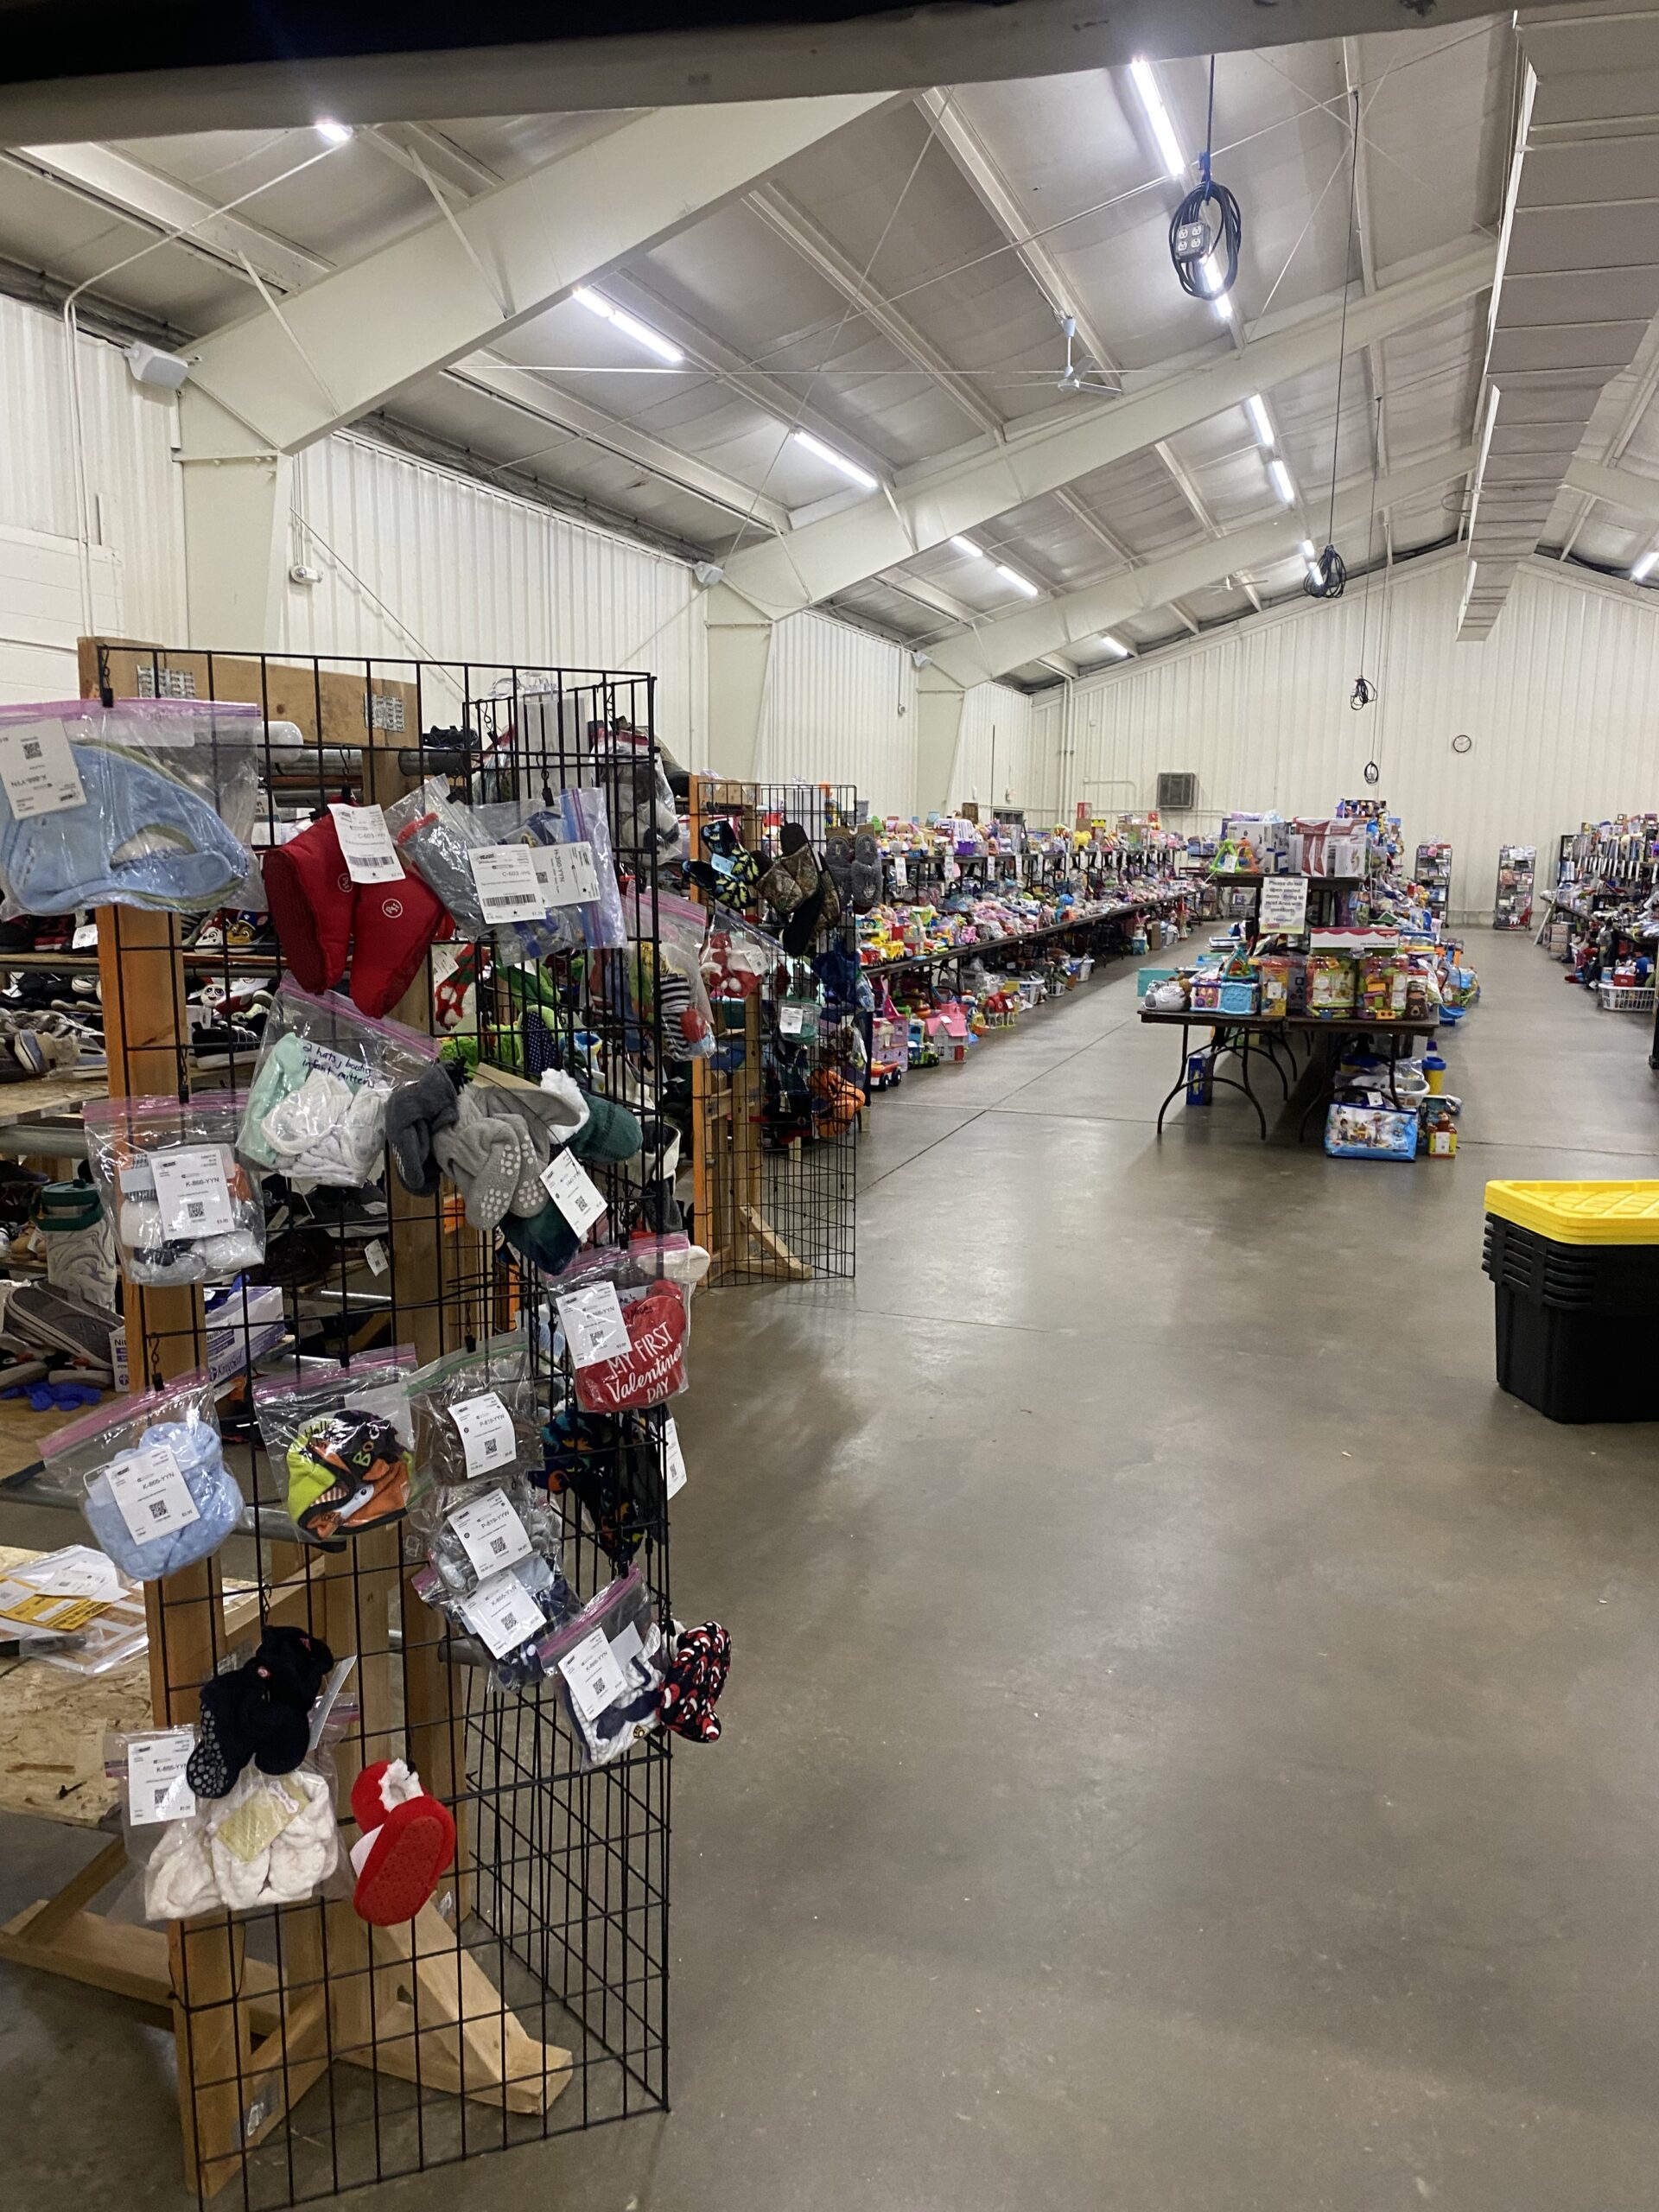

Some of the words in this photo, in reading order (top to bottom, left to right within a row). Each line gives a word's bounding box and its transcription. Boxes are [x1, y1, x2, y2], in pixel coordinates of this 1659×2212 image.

[607, 1352, 635, 1377] MY
[633, 1321, 673, 1362] FIRST
[646, 1376, 669, 1404] DAY
